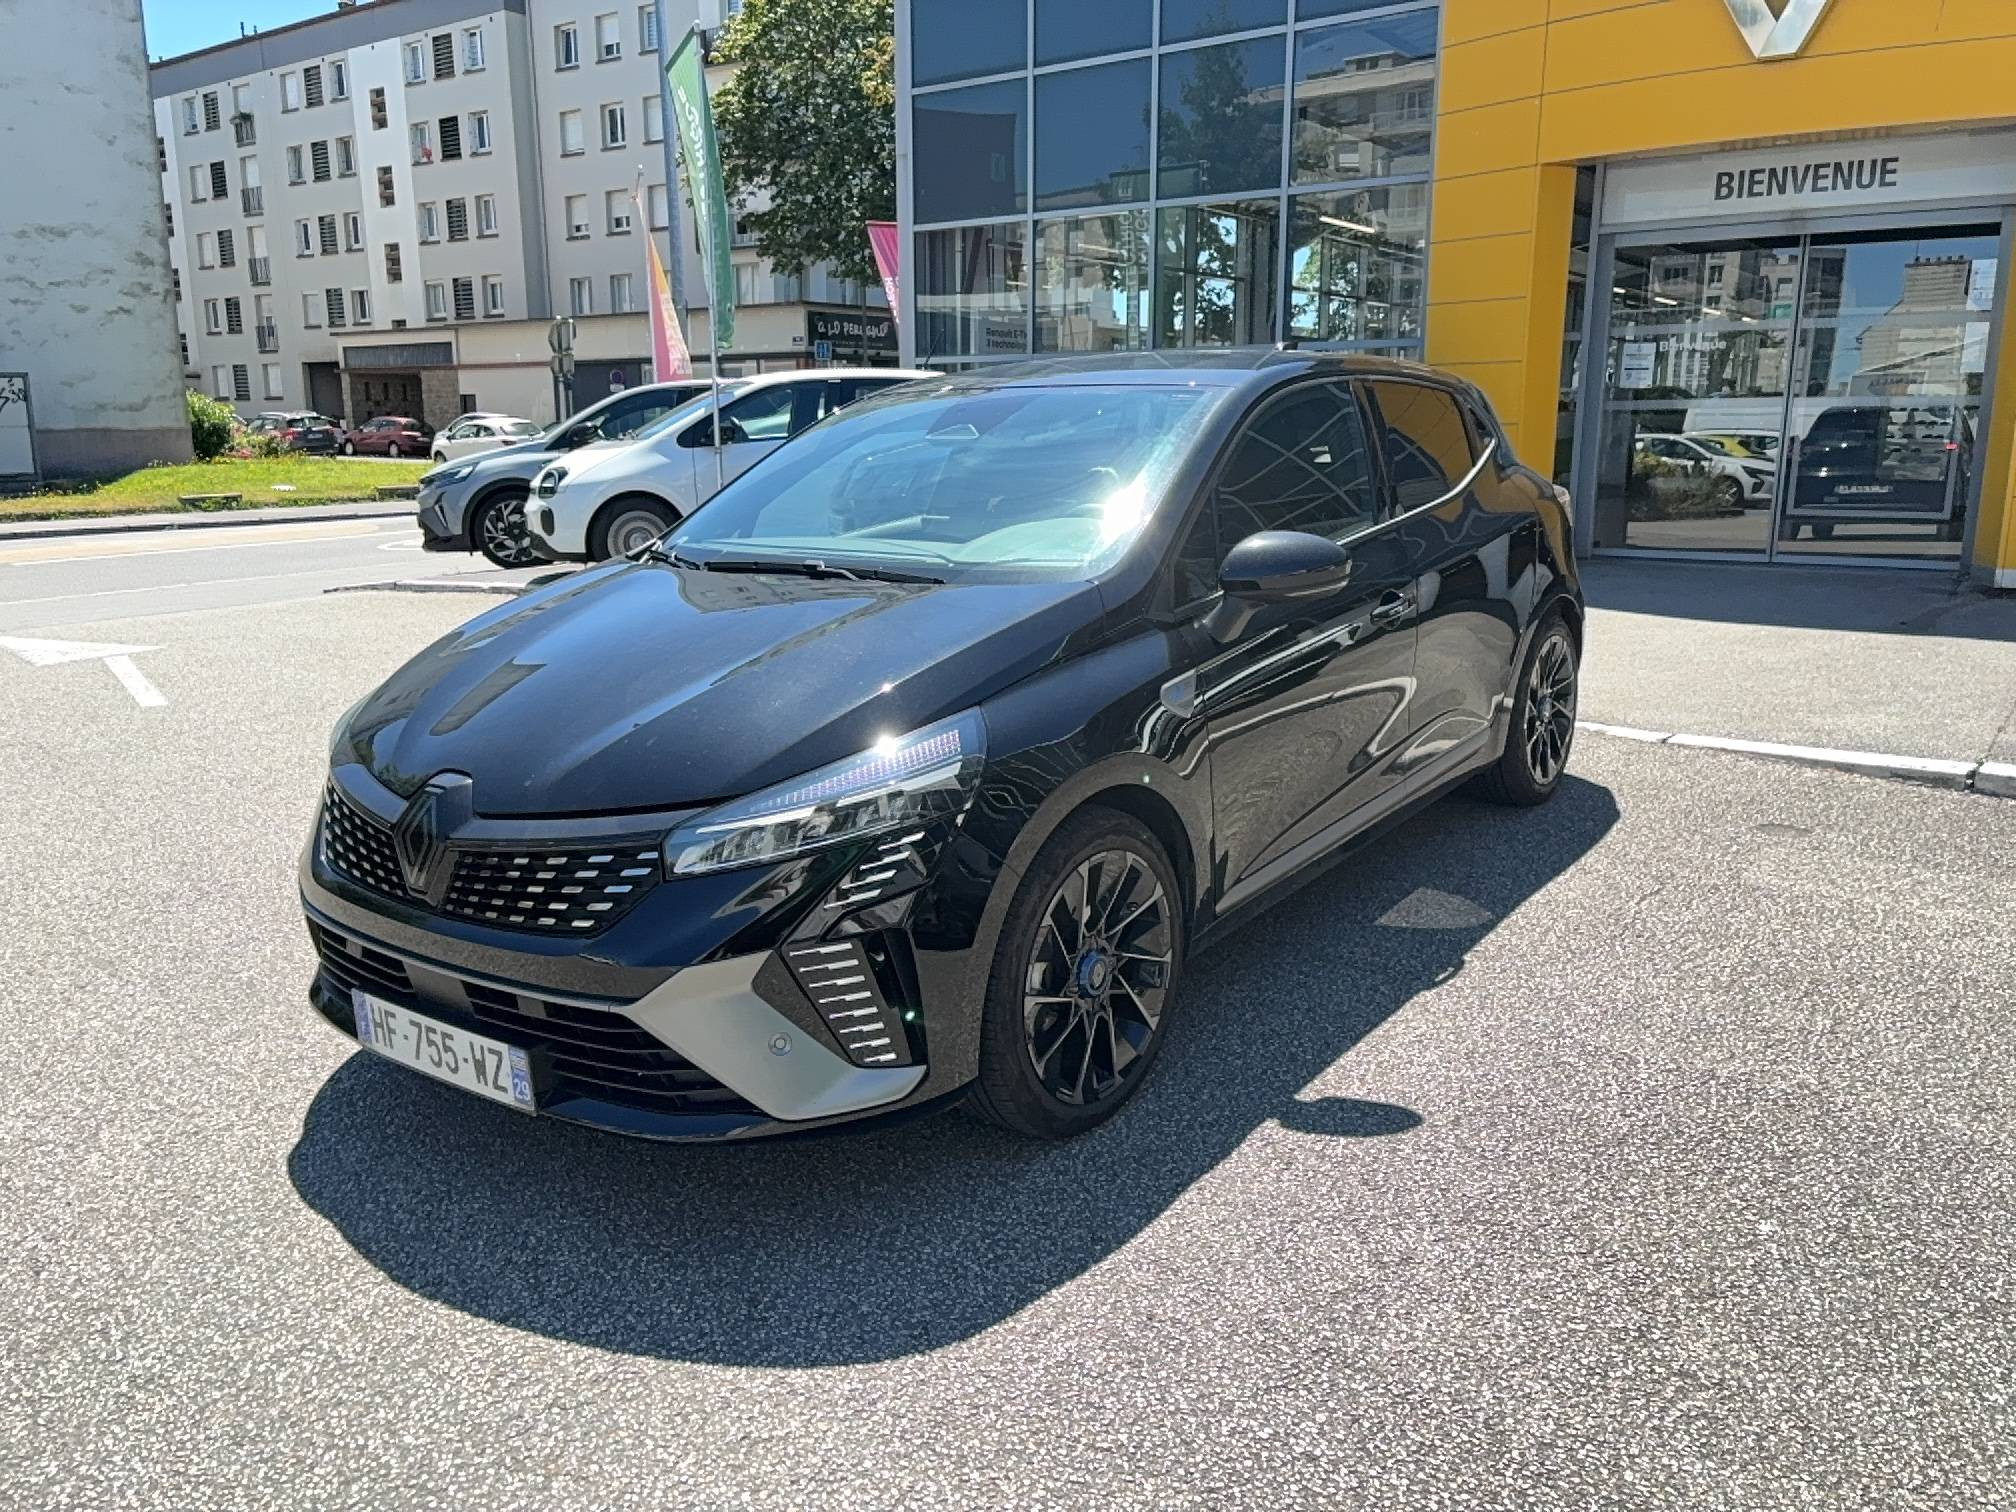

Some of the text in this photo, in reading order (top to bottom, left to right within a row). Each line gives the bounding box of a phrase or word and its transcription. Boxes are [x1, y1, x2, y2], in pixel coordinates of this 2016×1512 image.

[1714, 157, 1899, 200] BIENVENUE
[370, 1002, 509, 1095] HF-755-WZ
[513, 1077, 530, 1099] 29
